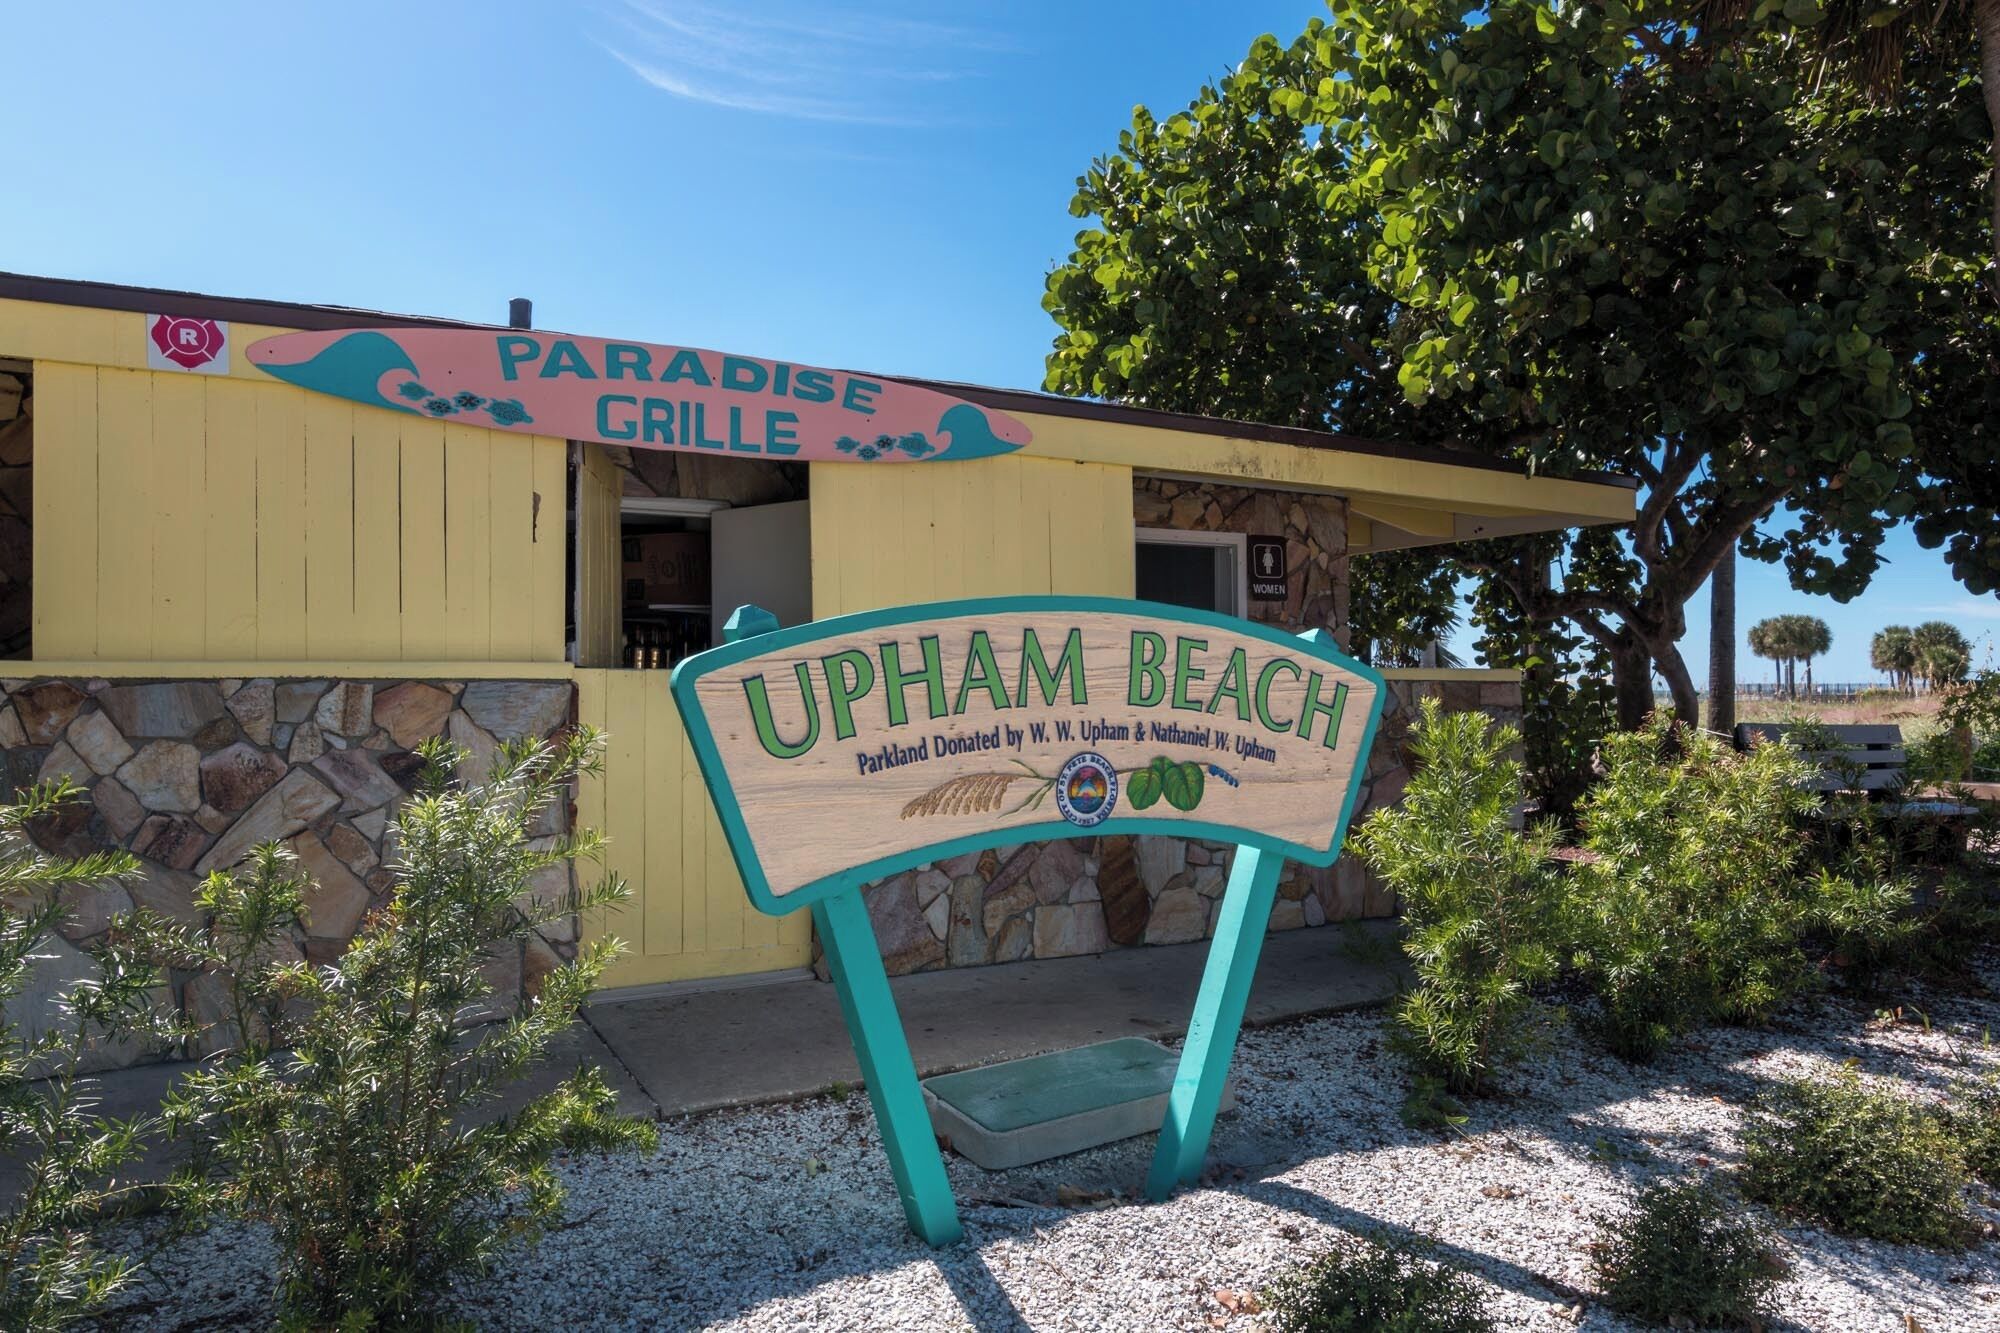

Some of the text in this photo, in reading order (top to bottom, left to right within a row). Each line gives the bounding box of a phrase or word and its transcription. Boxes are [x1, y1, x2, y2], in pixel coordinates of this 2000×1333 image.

[180, 328, 199, 346] R
[496, 335, 882, 414] PARADISE
[597, 394, 800, 455] GRILLE
[1253, 584, 1286, 594] WOMEN
[743, 627, 1350, 759] UPHAM BEACH
[856, 718, 1277, 776] Parkland Donated by W. W. Upham & Nathaniel W. Upham
